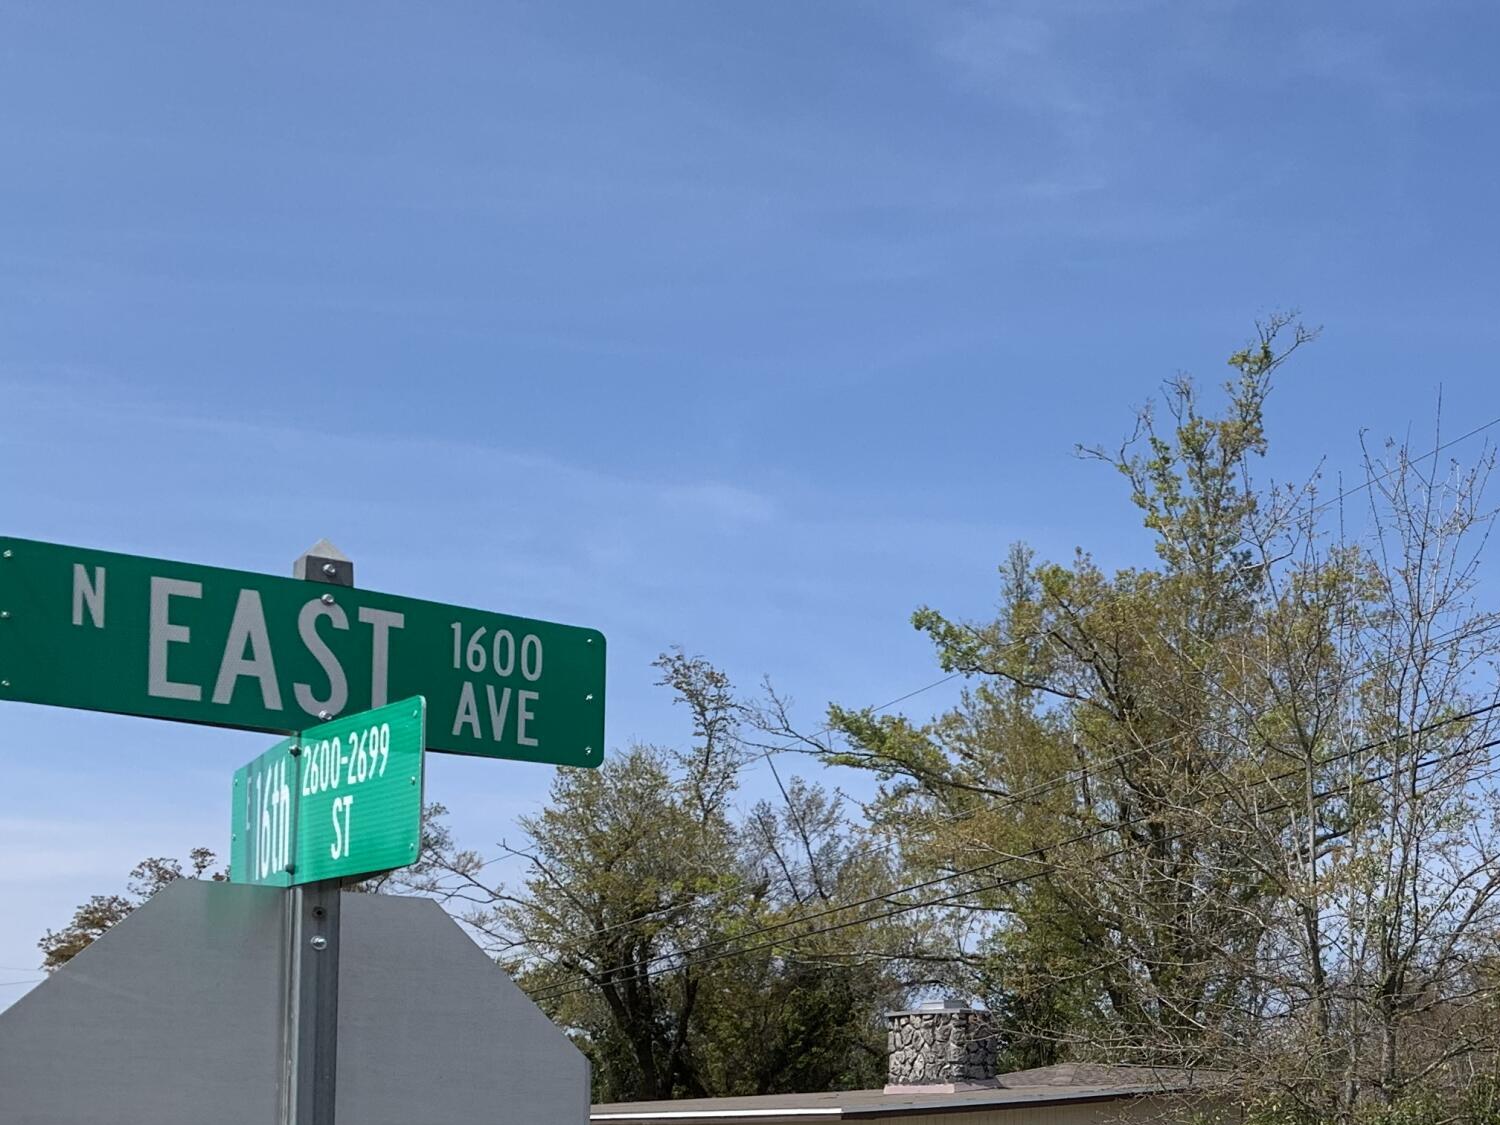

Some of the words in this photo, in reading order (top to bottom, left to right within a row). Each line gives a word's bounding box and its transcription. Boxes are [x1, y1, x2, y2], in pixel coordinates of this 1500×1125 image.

[72, 563, 106, 628] N
[147, 575, 405, 718] EAST
[450, 621, 543, 681] 1600
[451, 681, 540, 747] AVE
[302, 723, 390, 796] 2600-2699
[255, 757, 290, 880] 16th
[331, 795, 353, 860] ST
